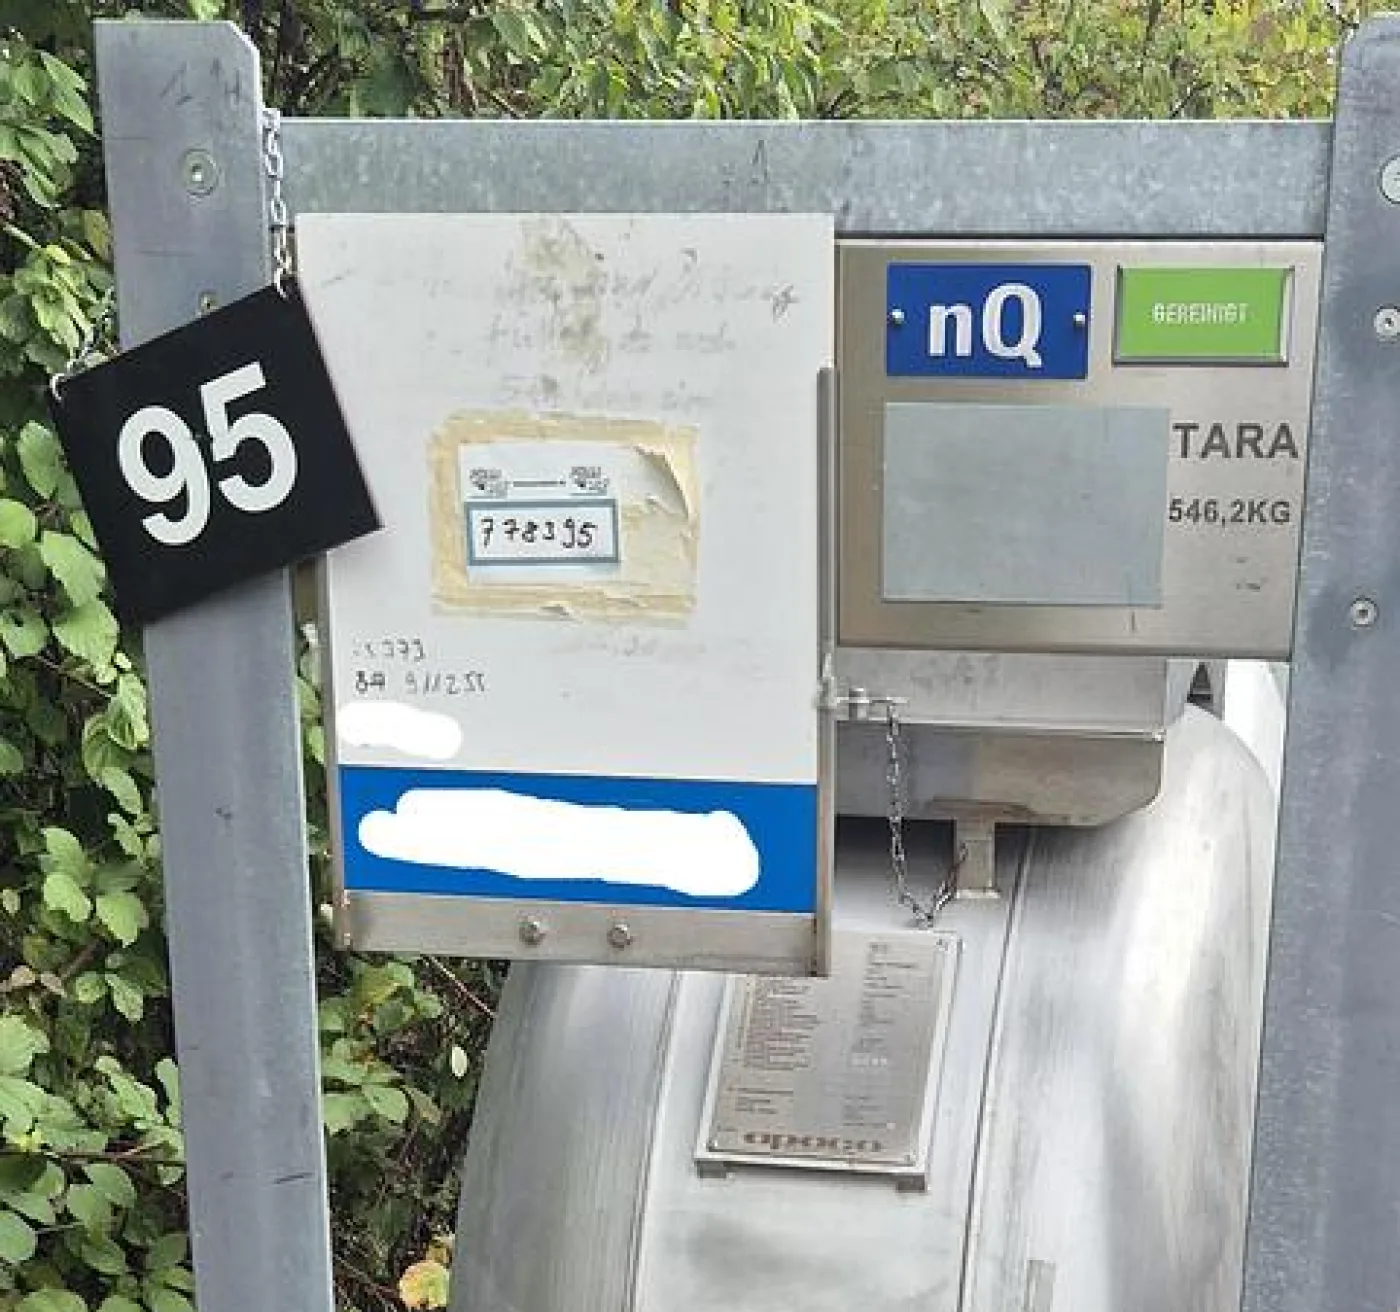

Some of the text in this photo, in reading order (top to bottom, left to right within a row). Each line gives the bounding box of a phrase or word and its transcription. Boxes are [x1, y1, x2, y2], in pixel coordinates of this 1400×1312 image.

[927, 283, 1042, 368] nQ
[1152, 302, 1248, 324] GEREINIGT
[118, 361, 297, 545] 95
[1172, 422, 1299, 459] TARA
[1168, 499, 1291, 527] 546,2KG
[480, 515, 598, 549] 778395
